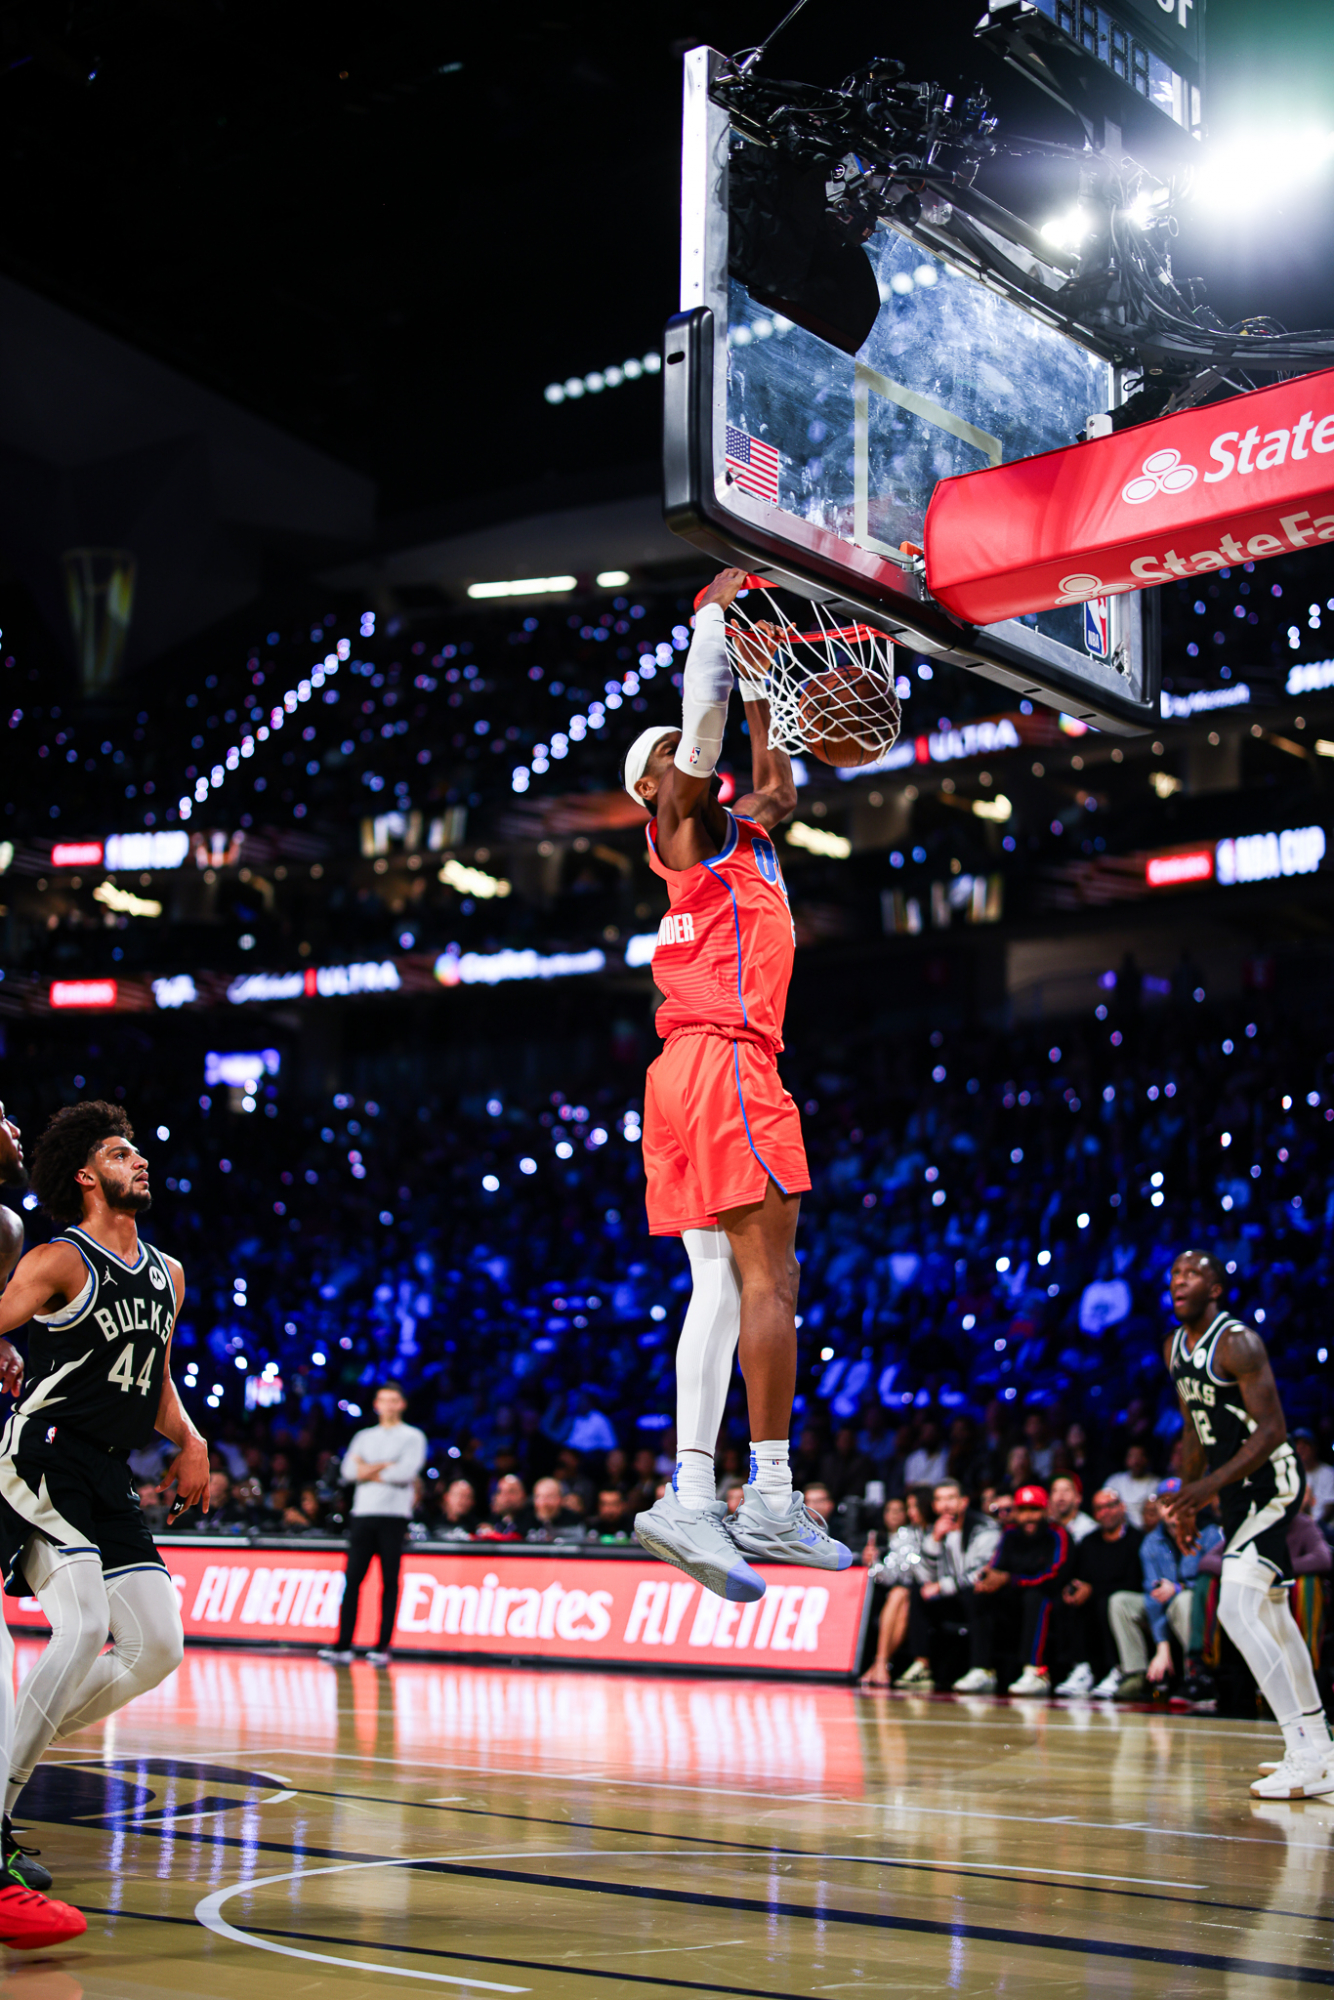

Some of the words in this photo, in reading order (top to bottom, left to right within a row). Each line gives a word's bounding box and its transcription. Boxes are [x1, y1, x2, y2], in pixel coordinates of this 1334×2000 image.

[93, 1298, 173, 1345] BUCKS
[107, 1342, 156, 1396] 44
[190, 1565, 250, 1623] FLY
[397, 1572, 613, 1641] Emirates
[623, 1580, 696, 1645] FLY
[688, 1584, 829, 1652] BETTER
